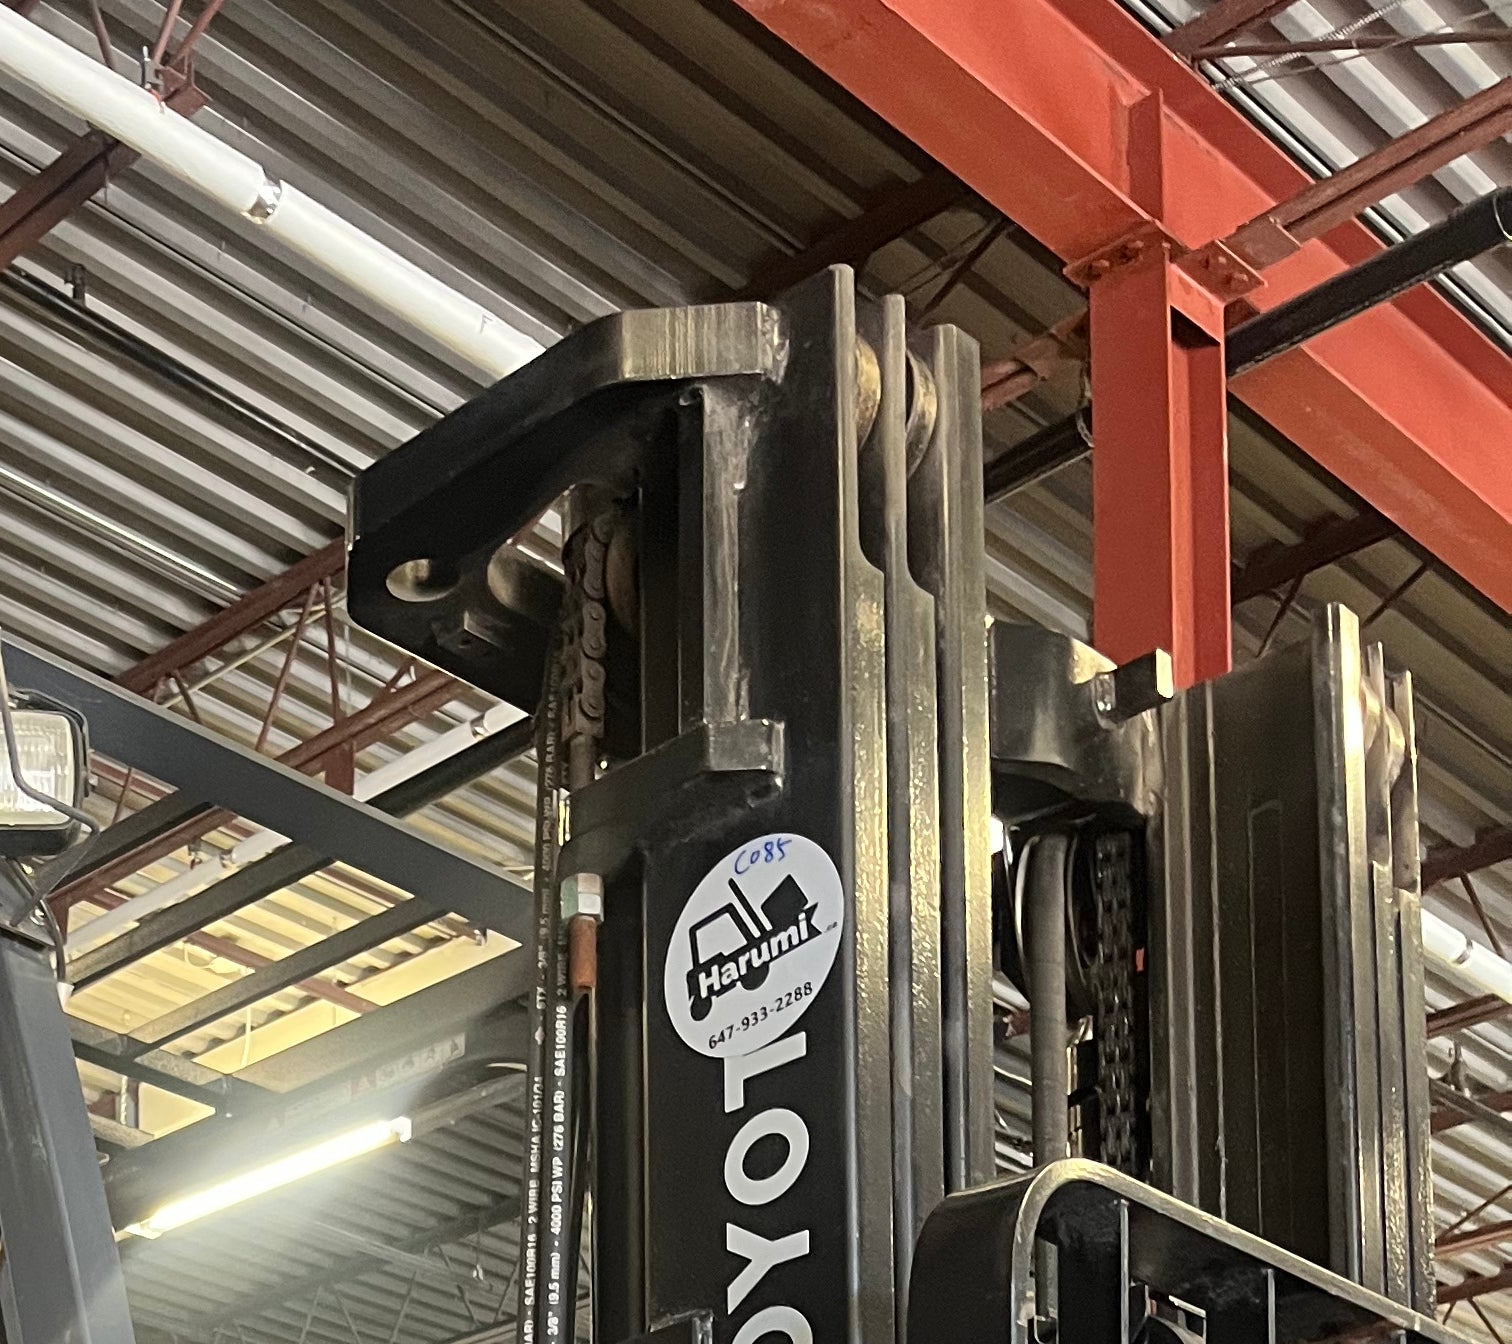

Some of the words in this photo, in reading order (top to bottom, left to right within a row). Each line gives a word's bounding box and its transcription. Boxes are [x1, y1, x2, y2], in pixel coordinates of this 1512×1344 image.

[698, 912, 809, 999] Harumi
[708, 981, 813, 1050] 647-933-2288
[553, 1005, 567, 1077] SAE100R16
[553, 1090, 566, 1123] BAR)
[552, 1124, 565, 1152] (276
[552, 1156, 564, 1179] WP
[551, 1180, 563, 1203] PSI
[550, 1204, 562, 1236] 4000
[549, 1252, 561, 1280] mm)
